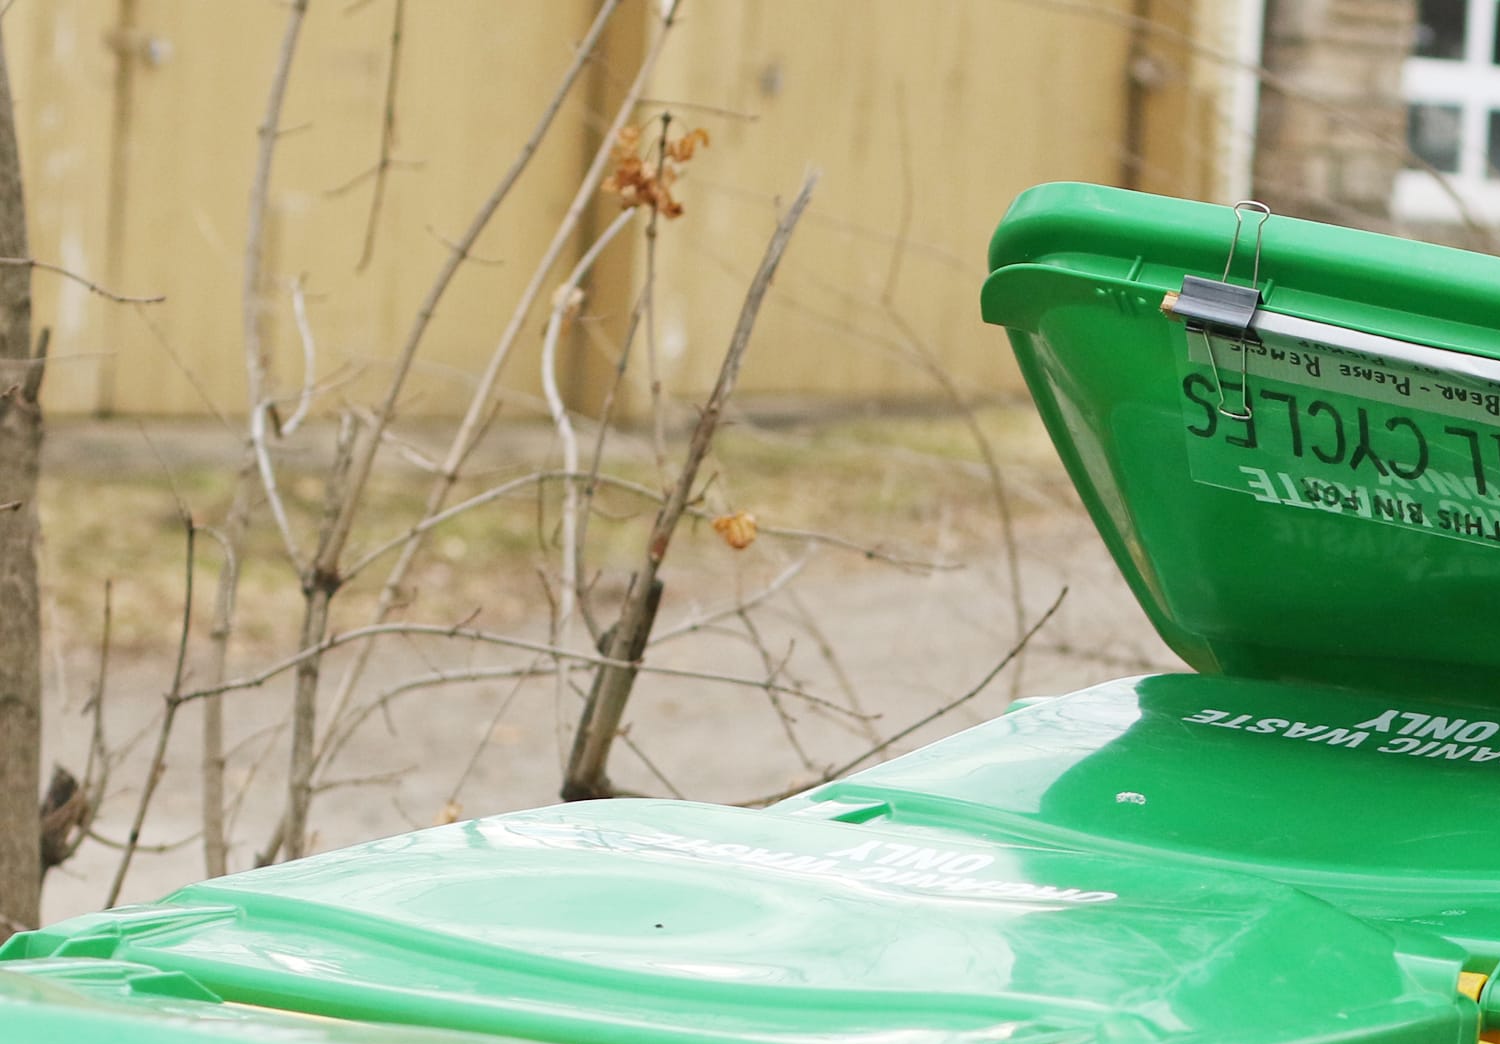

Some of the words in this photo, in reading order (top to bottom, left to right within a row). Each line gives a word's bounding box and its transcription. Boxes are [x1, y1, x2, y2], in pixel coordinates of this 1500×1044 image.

[1339, 363, 1411, 396] PLEASE
[1435, 384, 1500, 416] BEAR
[1182, 372, 1430, 481] CYCLES
[1301, 479, 1360, 511] FOR
[1374, 495, 1425, 525] BIN
[1182, 709, 1370, 748] WASTE
[1353, 709, 1500, 744] ONLY
[824, 840, 996, 875] ONLY
